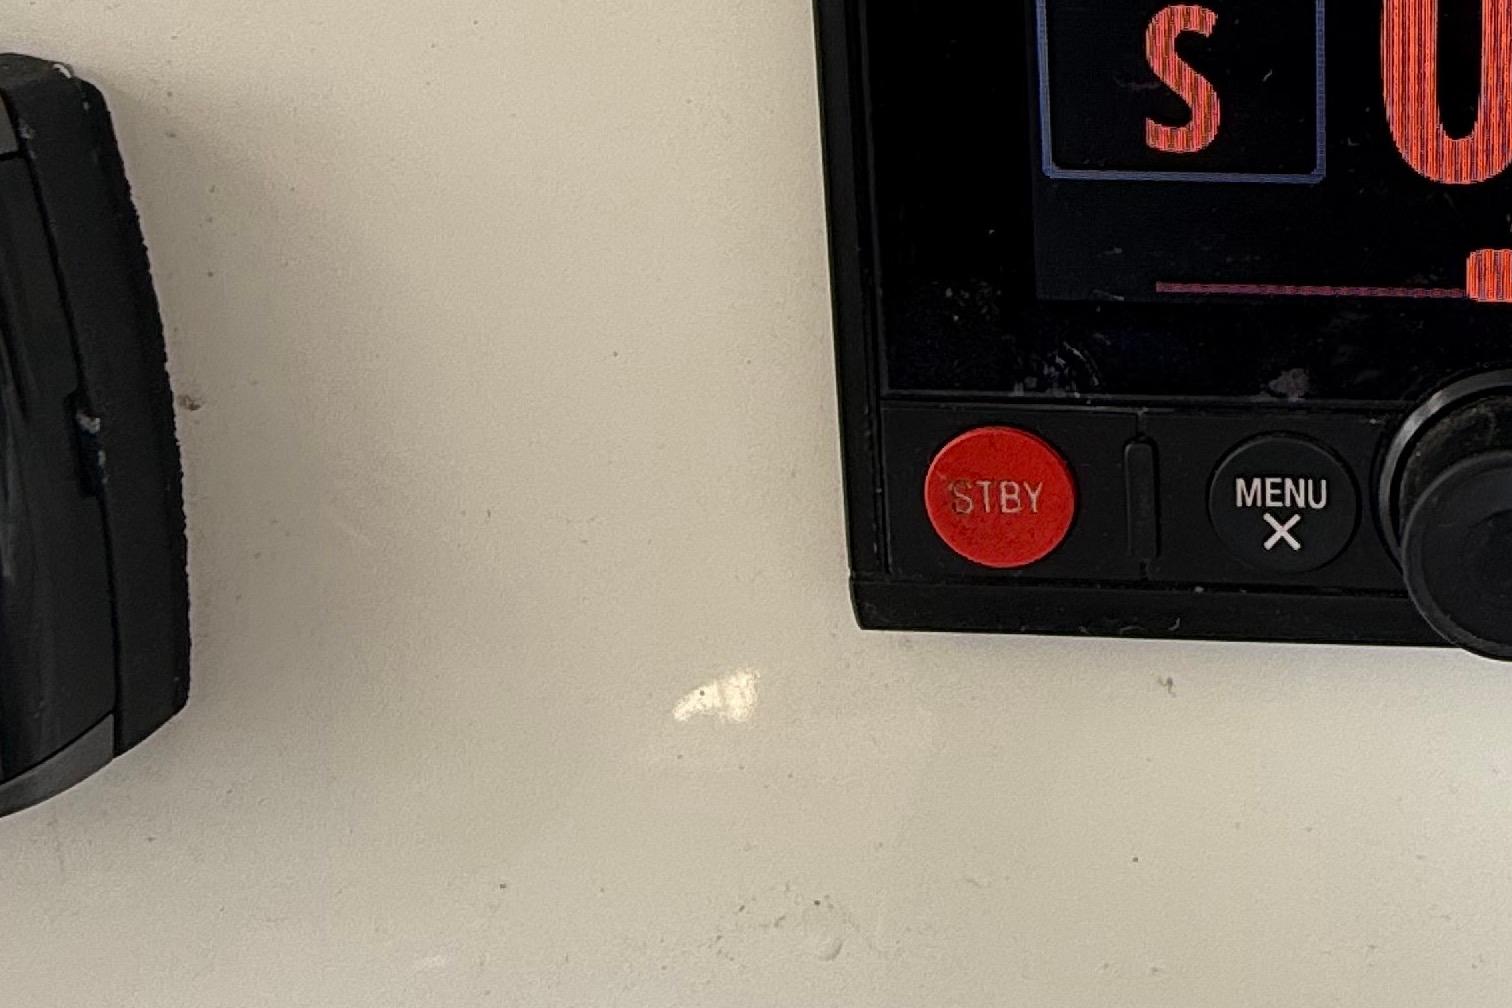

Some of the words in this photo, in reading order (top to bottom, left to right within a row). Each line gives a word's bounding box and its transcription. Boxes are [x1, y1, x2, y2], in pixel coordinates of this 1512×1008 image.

[1145, 4, 1221, 153] S
[951, 480, 1043, 514] STBY
[1235, 477, 1328, 510] MENU
